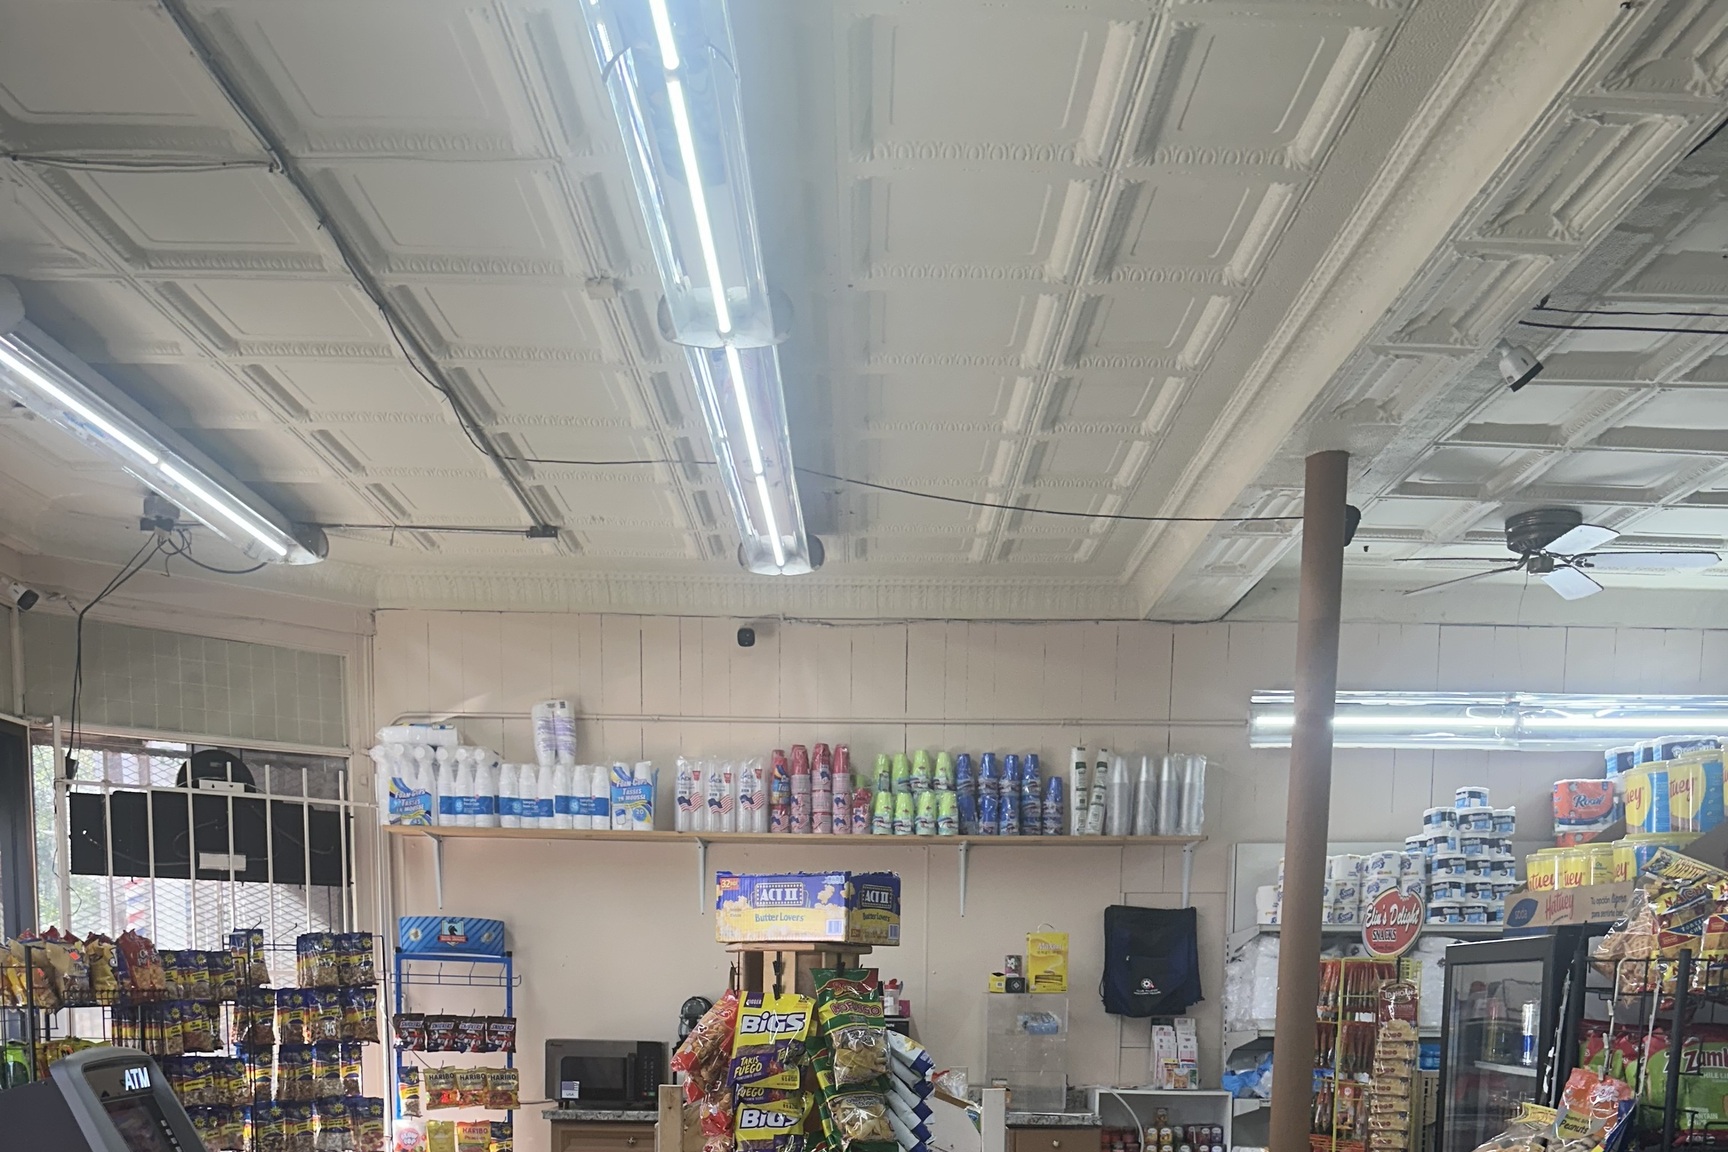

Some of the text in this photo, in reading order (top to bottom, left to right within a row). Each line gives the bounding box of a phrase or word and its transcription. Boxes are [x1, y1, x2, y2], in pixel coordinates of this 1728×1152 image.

[760, 888, 798, 901] ACT II
[865, 891, 889, 904] ACT II
[1545, 892, 1575, 919] Hatuey
[755, 912, 804, 922] Butter Lovers
[1389, 902, 1420, 932] Delight
[1514, 907, 1528, 919] soda
[1372, 928, 1397, 942] SNACKS
[490, 1023, 513, 1031] SNICKERS
[740, 1055, 759, 1065] TAKIS
[429, 1072, 455, 1081] HARIBO
[460, 1073, 486, 1081] HARIBO
[734, 1063, 763, 1078] FUEGO
[124, 1066, 151, 1091] ATM
[462, 1127, 488, 1135] HARIBO
[1560, 1120, 1589, 1135] Peanuts
